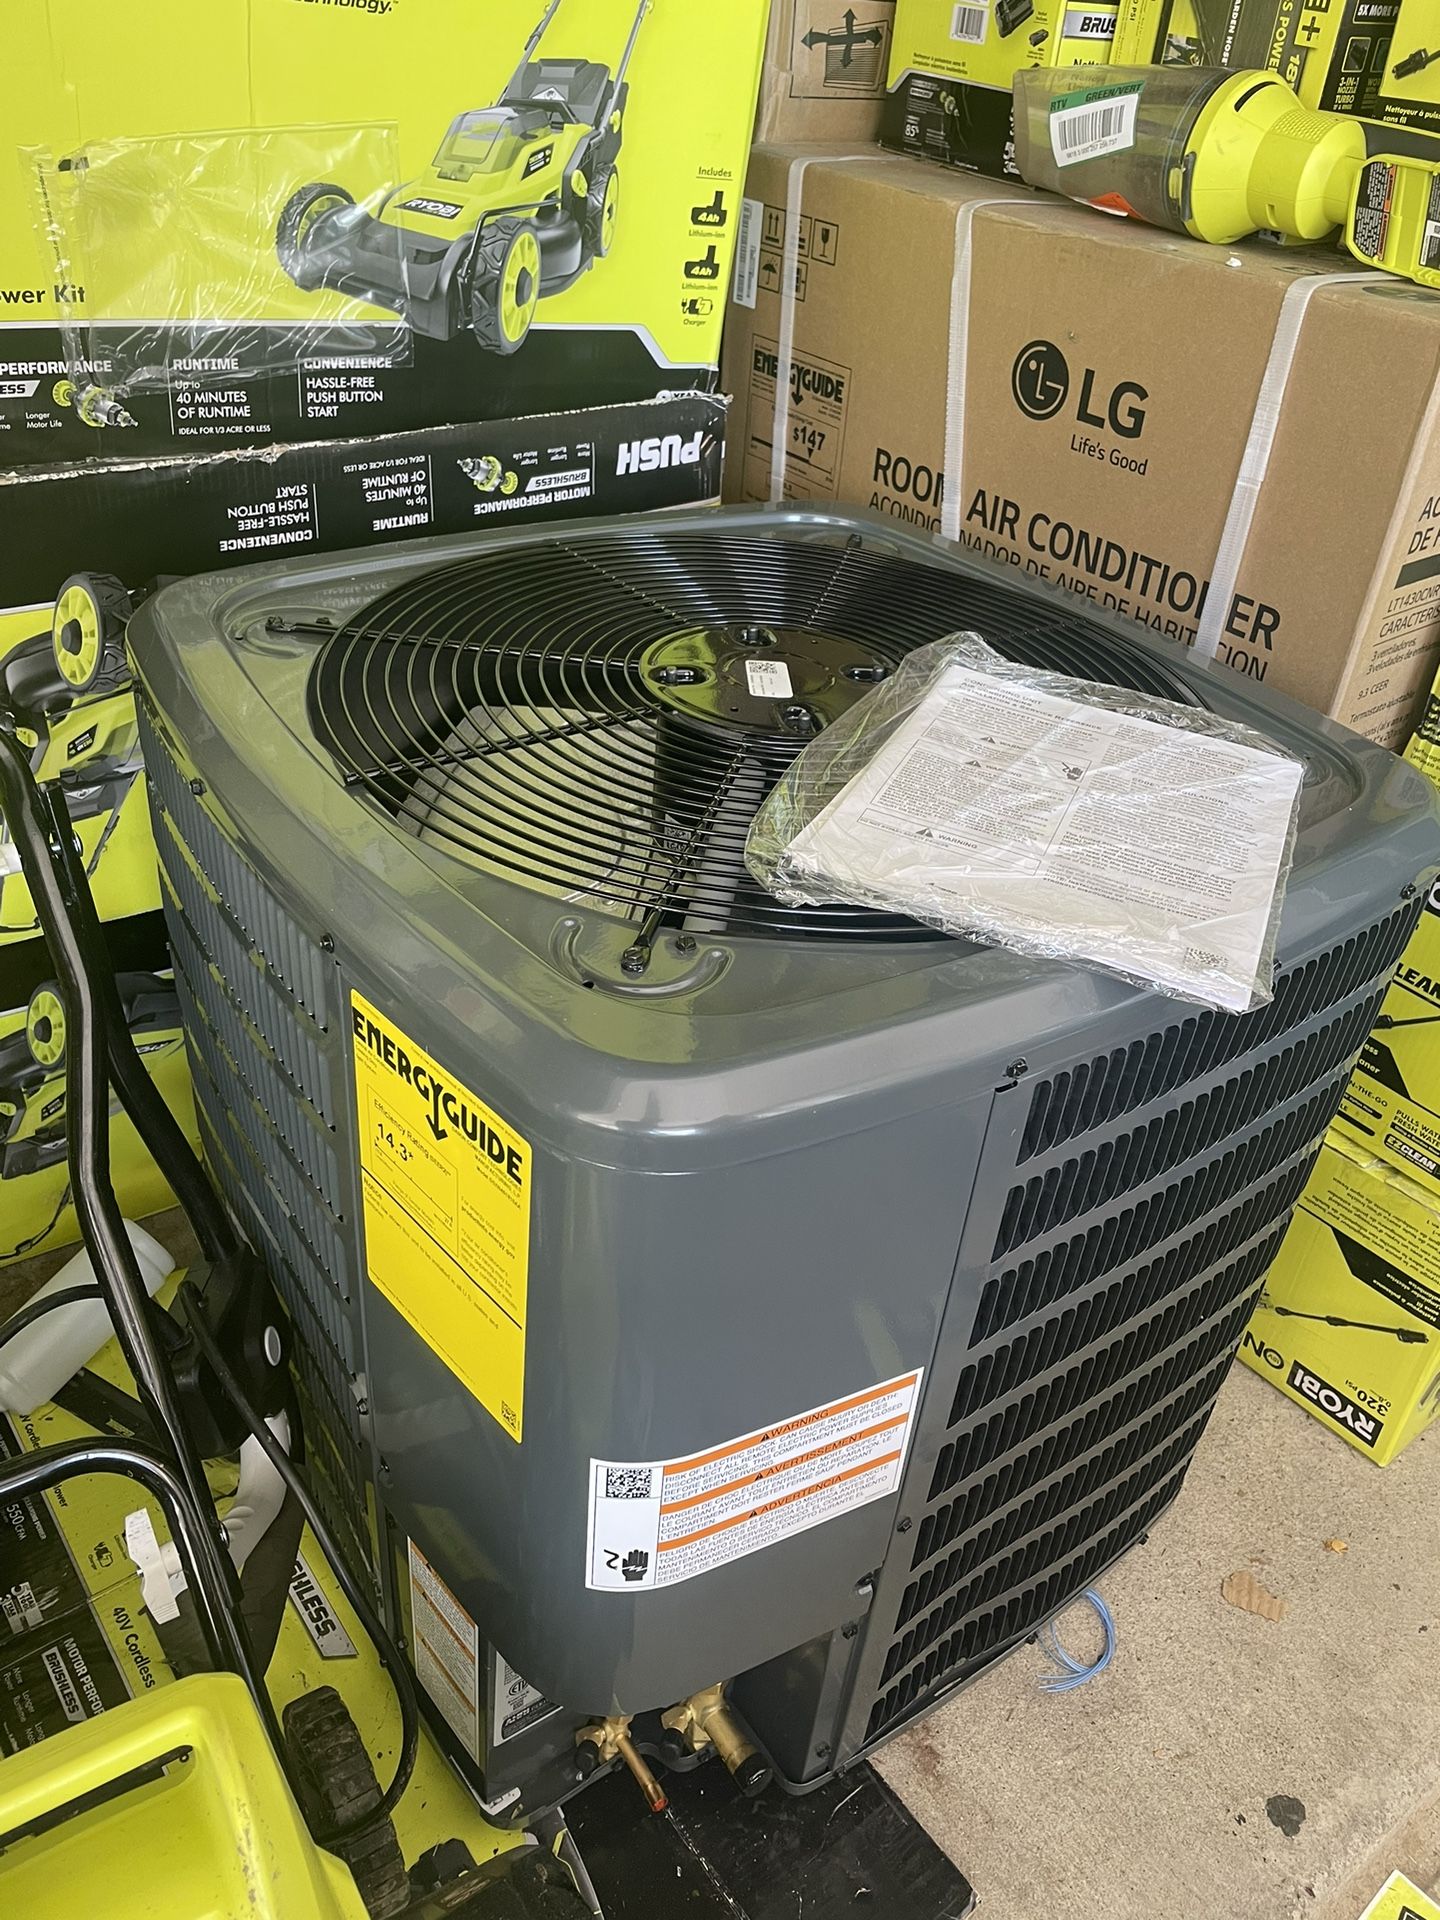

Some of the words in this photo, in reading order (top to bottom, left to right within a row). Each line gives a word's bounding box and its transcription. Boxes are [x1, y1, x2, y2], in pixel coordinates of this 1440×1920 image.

[1358, 5, 1369, 16] 5X
[1369, 4, 1391, 16] MORE
[1050, 99, 1068, 112] RTV
[1086, 83, 1142, 102] GREEN/VERT
[698, 166, 732, 178] Includes
[405, 199, 462, 217] RYOBI
[698, 211, 720, 223] 4Ah
[690, 265, 713, 276] 4Ah
[54, 284, 85, 304] Kit
[683, 318, 706, 327] Charger
[173, 358, 240, 371] RUNTIME
[303, 357, 393, 370] CONVENIENCE
[306, 376, 376, 389] HASSLE-FREE
[753, 349, 846, 404] ENEGYGUIDE
[176, 393, 192, 404] 40
[194, 391, 248, 404] MINUTES
[306, 391, 337, 404] PUSH
[339, 391, 384, 403] BUTTON
[1076, 368, 1150, 439] LG
[25, 411, 51, 421] Longer
[178, 408, 195, 420] OF
[198, 405, 252, 418] RUNTIME
[306, 405, 339, 418] START
[26, 420, 48, 430] Motor
[49, 419, 63, 429] Life
[178, 427, 198, 435] IDEAL
[199, 427, 214, 435] FOR
[225, 425, 244, 434] ACRE
[245, 425, 255, 433] OR
[256, 425, 271, 433] LESS
[793, 425, 826, 451] $147
[615, 431, 704, 476] PUSH
[1070, 433, 1106, 462] Life's
[1109, 447, 1150, 476] Good
[343, 464, 357, 473] LESS
[410, 470, 426, 482] OF
[362, 472, 409, 489] RUNTIME
[535, 471, 587, 487] BRUSHLESS
[275, 484, 308, 499] START
[365, 486, 412, 503] MINUTES
[413, 484, 427, 496] 40
[553, 486, 591, 502] MOTOR
[227, 501, 275, 519] BUTTON
[277, 498, 309, 512] PUSH
[406, 498, 414, 506] to
[415, 496, 428, 506] Up
[474, 492, 553, 515] PERFORMANCE
[238, 511, 310, 531] HASSLE-FREE
[373, 512, 429, 531] RUNTIME
[966, 488, 1021, 542] AIR
[220, 529, 313, 552] CONVENIENCE
[1407, 527, 1434, 556] DE
[938, 832, 979, 850] WARNING
[352, 1006, 523, 1187] ENERGYGUIDE
[373, 1098, 405, 1136] Efficiency
[1393, 1115, 1418, 1134] FRESH
[1395, 1108, 1420, 1127] PULLS
[1345, 1378, 1358, 1392] PSI
[1293, 1367, 1376, 1441] RYOBI
[1356, 1389, 1389, 1417] 320
[771, 1409, 830, 1438] WARNING
[664, 1482, 701, 1496] BEFORE
[703, 1462, 750, 1483] SERVICING.
[753, 1454, 772, 1465] THIS
[773, 1428, 834, 1457] COMPARTMENT
[836, 1420, 858, 1432] MUST
[860, 1416, 871, 1424] BE
[872, 1403, 903, 1418] CLOSED
[665, 1473, 686, 1482] RISK
[688, 1468, 701, 1478] OF
[703, 1452, 744, 1472] ELECTRIC
[747, 1440, 778, 1456] SHOCK.
[780, 1432, 798, 1442] CAN
[798, 1421, 825, 1436] CAUSE
[828, 1409, 856, 1423] INJURY
[857, 1404, 869, 1412] OR
[665, 1466, 722, 1490] DISCONNECT
[724, 1461, 739, 1470] ALL
[741, 1445, 777, 1463] REMOTE
[778, 1430, 818, 1448] ELECTRIC
[819, 1418, 848, 1436] POWER
[850, 1403, 887, 1422] SUPPLIES
[766, 1431, 864, 1476] AVERTISSEMENT
[662, 1506, 699, 1522] DANGER
[715, 1492, 739, 1506] CHOC
[846, 1435, 878, 1451] COUPEZ
[880, 1427, 899, 1437] TOUT
[771, 1466, 816, 1488] ENTRETIEN
[663, 1488, 699, 1503] EXCEPT
[701, 1478, 727, 1491] WHEN
[760, 1475, 842, 1514] ADVERTENCIA
[6, 1503, 25, 1526] 550
[661, 1508, 729, 1534] COMPARTIMENT
[14, 1523, 28, 1542] CFM
[63, 1637, 88, 1677] MOTOR
[112, 1605, 134, 1631] 40V
[124, 1632, 156, 1690] Cordless
[45, 1651, 81, 1715] BRUSHLESS
